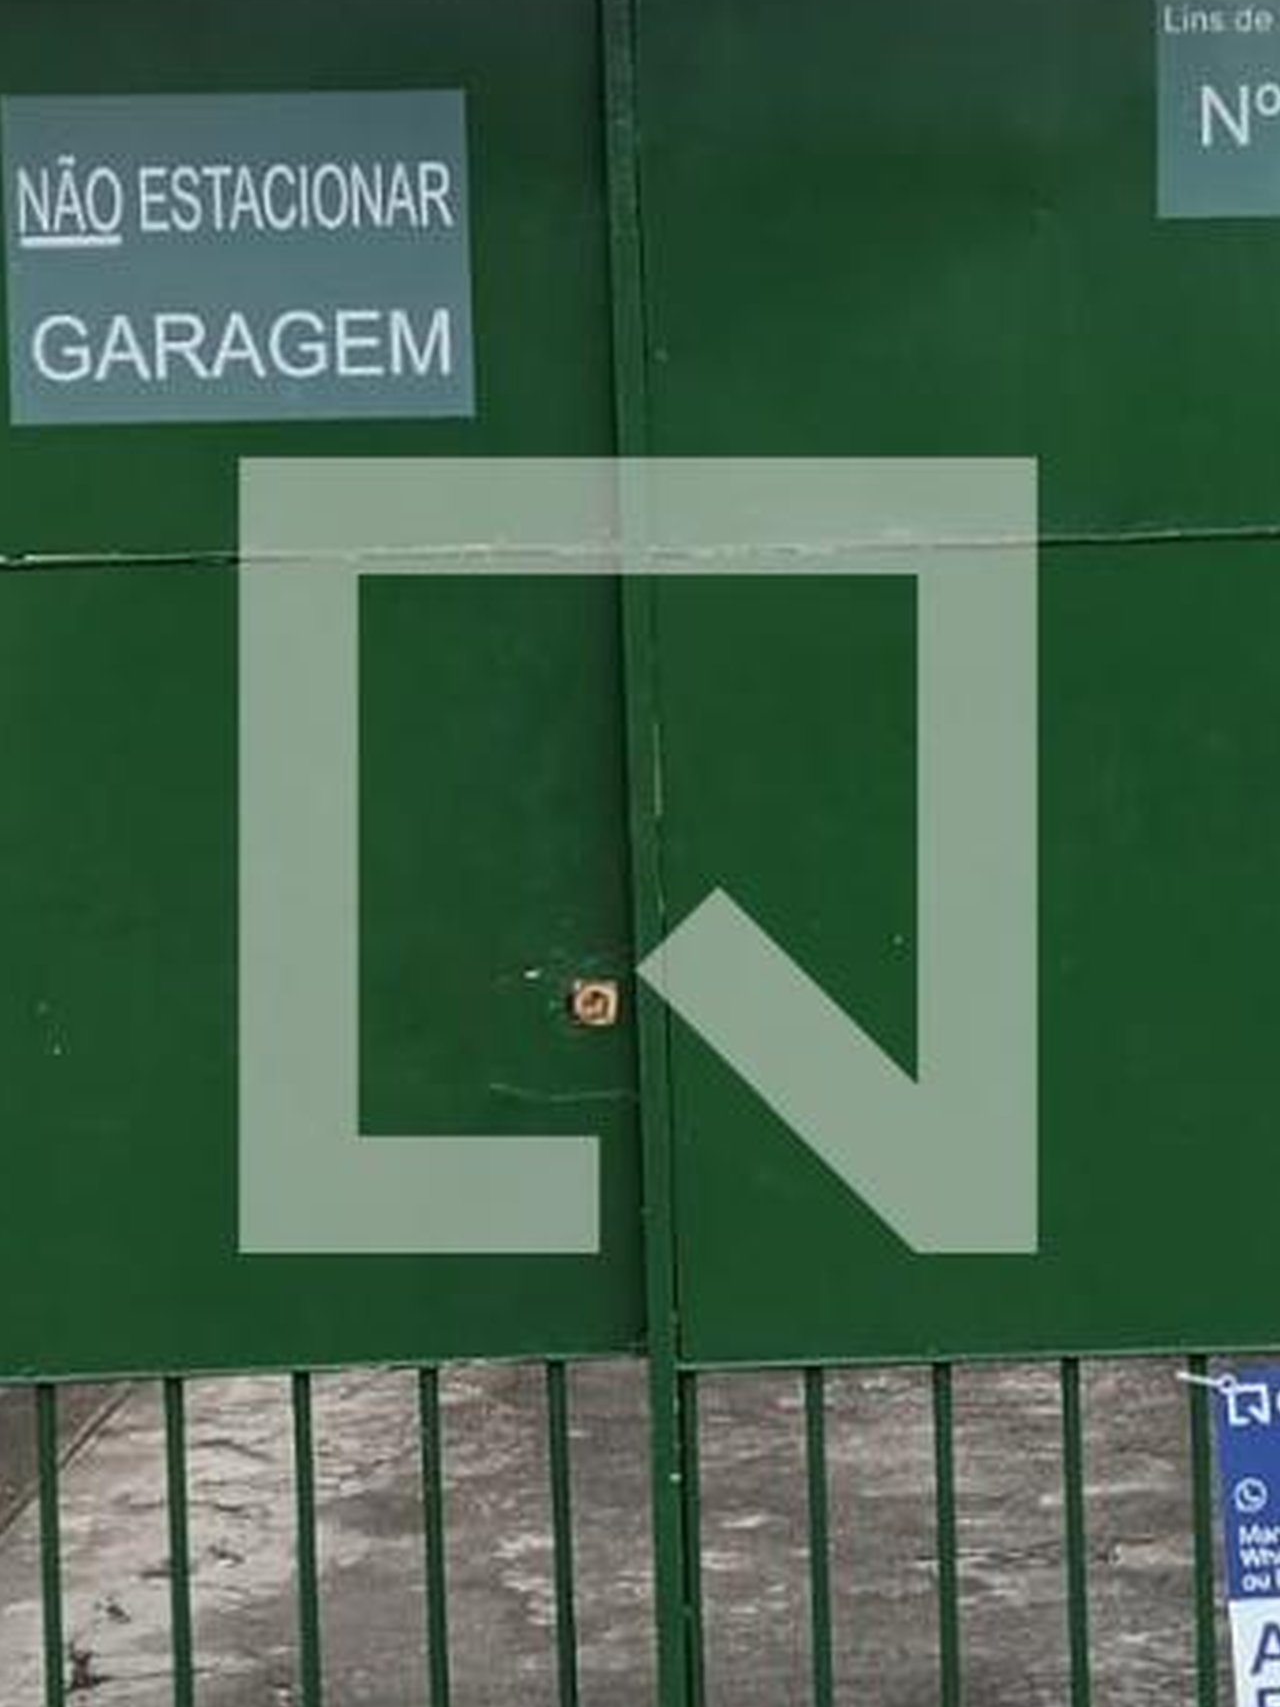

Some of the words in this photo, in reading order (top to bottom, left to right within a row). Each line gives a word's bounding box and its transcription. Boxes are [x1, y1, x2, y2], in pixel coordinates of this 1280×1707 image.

[1163, 5, 1222, 34] Lins
[1235, 5, 1274, 31] de
[18, 155, 122, 234] NÃO
[139, 161, 454, 232] ESTACIONAR
[32, 308, 452, 381] GARAGEM
